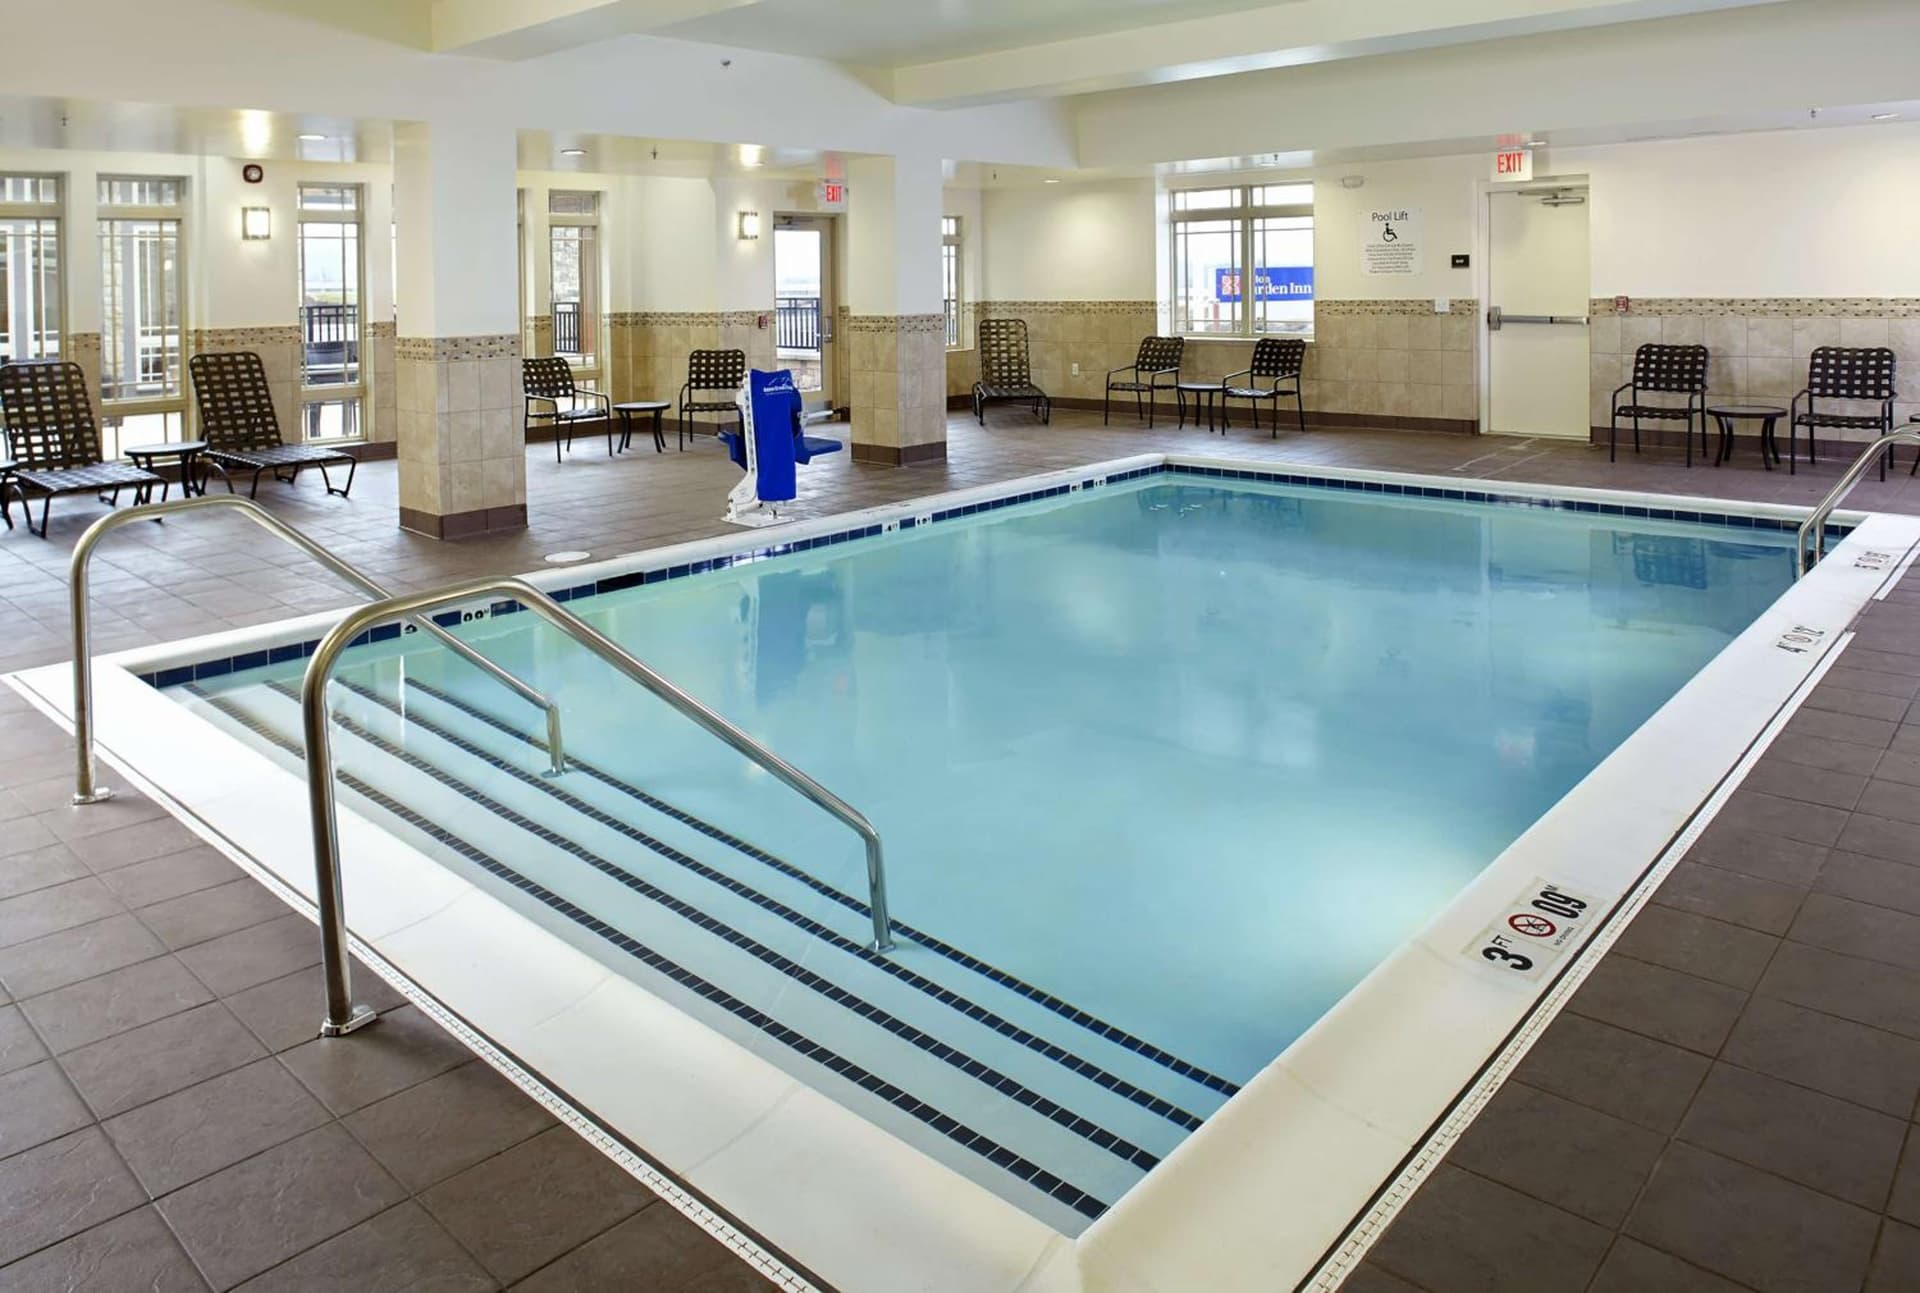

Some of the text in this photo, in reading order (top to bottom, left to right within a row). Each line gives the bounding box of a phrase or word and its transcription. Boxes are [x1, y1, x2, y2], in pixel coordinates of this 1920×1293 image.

[1497, 152, 1523, 173] EXIT
[826, 185, 842, 202] EXIT
[1371, 210, 1408, 221] Pool Lift
[1255, 282, 1312, 296] rden Inn
